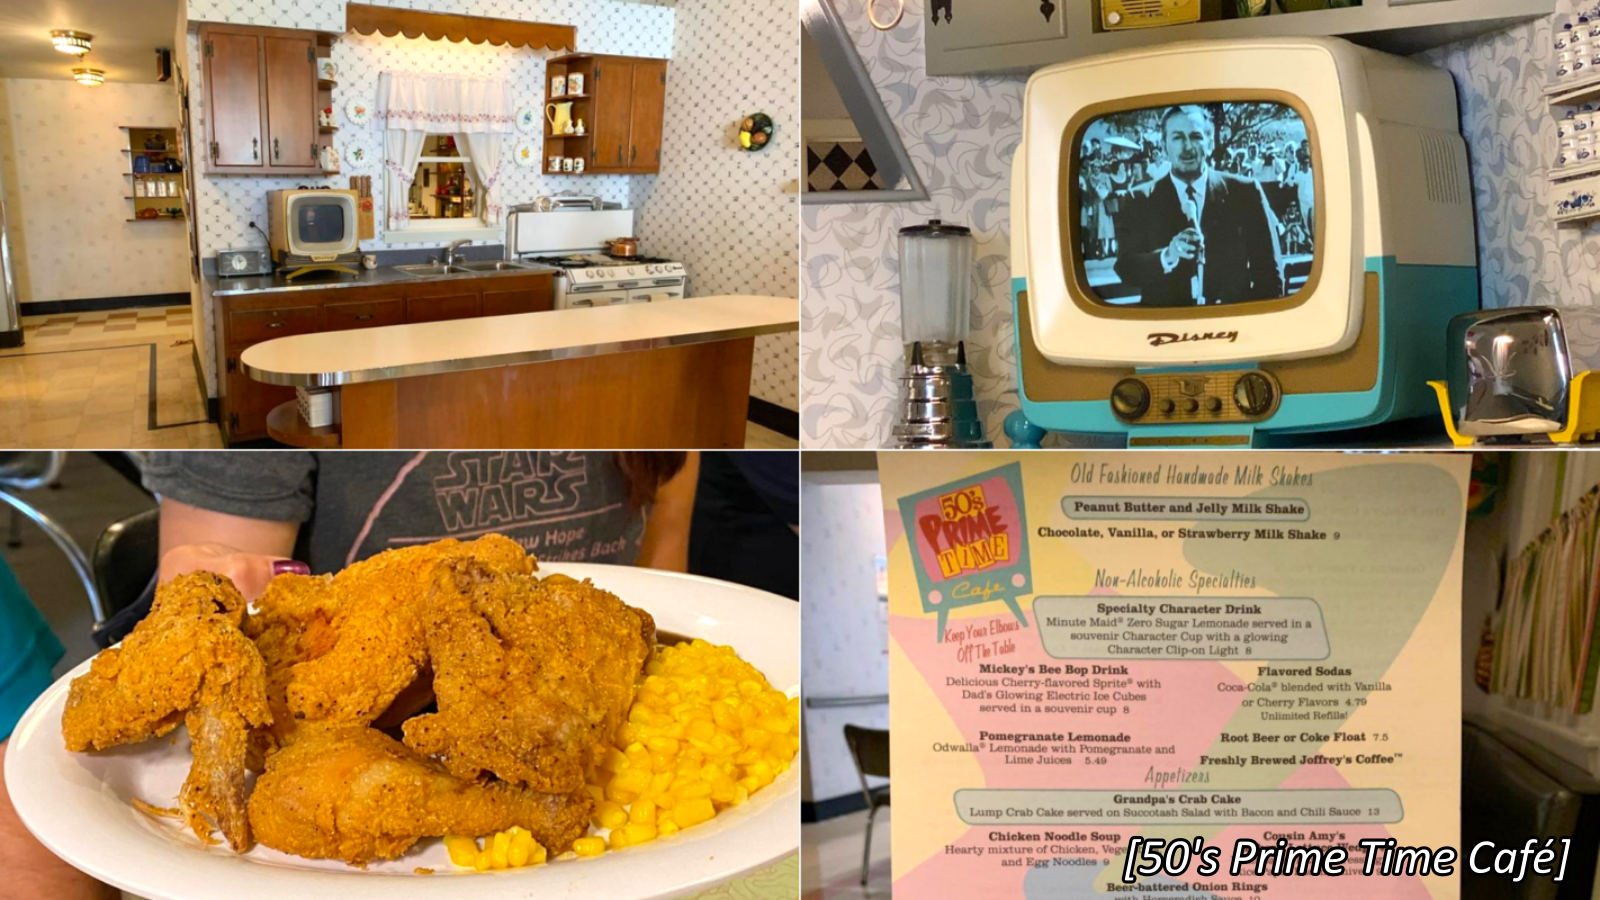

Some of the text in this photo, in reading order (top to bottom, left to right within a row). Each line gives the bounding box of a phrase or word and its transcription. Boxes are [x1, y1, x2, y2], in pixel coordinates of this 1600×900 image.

[1147, 330, 1239, 346] Disney
[433, 451, 586, 491] STAR
[1070, 462, 1314, 487] Old Fashioned Handmade Milk Shakes
[436, 470, 588, 532] WARS
[943, 491, 985, 520] 50's
[1074, 501, 1305, 516] Peanut Butter and Jelly Milk Shake
[919, 505, 1009, 554] PRIME
[1037, 526, 1340, 541] Chocolate, Vanilla, or Strawberry Milk Shake 9
[545, 526, 586, 547] Hope
[590, 539, 626, 557] Back
[940, 535, 1007, 574] TIME
[1095, 568, 1256, 595] Non-Alcoholic Specialties
[1097, 603, 1262, 616] Specialty Character Drink
[1046, 617, 1087, 627] Minute
[1127, 617, 1153, 628] Zero
[1155, 617, 1189, 629] Sugar
[1192, 618, 1249, 628] Lemonade
[1252, 619, 1288, 629] served
[1291, 619, 1302, 629] in
[1305, 621, 1312, 629] a
[944, 619, 1020, 645] Keep Your Elbows
[1070, 630, 1289, 644] souvenir Character Cup with a glowing
[957, 641, 1016, 663] Off The Table
[1107, 644, 1252, 657] Character Clip-on Light 8
[979, 664, 1129, 677] Mickey's Bee Bop Drink
[1257, 666, 1352, 677] Flavored Sodas
[945, 676, 999, 687] Delicious
[1001, 677, 1090, 689] Cherry-flavored
[1136, 679, 1162, 689] with
[1281, 682, 1323, 692] blended
[1327, 682, 1351, 692] with
[1355, 681, 1392, 691] Vanilla
[962, 690, 1147, 702] Dad's Glowing Electric Ice Cubes
[979, 703, 1130, 716] served in a souvenir cup 8
[1242, 697, 1368, 709] or Cherry Flavors 4.79
[1260, 710, 1348, 721] Unlimited Refills!
[979, 731, 1131, 743] Pomegranate Lemonade
[1220, 732, 1389, 743] Root Beer or Coke Float 7.5
[989, 743, 1047, 754] Lemonade
[1051, 744, 1075, 754] with
[1079, 744, 1152, 756] Pomegranate
[1155, 745, 1176, 754] and
[1004, 755, 1107, 765] Lime Juices 5.49
[1200, 755, 1247, 767] Freshly
[1250, 755, 1297, 766] Brewed
[1299, 754, 1352, 767] Joffrey's
[1144, 765, 1211, 789] Appetizers
[1113, 794, 1242, 806] Grandpa's Crab Cake
[969, 806, 1380, 819] Lump Crab Cake served on Succotash Salad with Bacon and Chili Sauce 13
[988, 831, 1121, 844] Chicken Noodle Soup
[1263, 830, 1346, 842] Cousin Amy's
[944, 845, 985, 857] Hearty
[988, 845, 1034, 855] mixture
[1036, 845, 1048, 855] of
[1050, 844, 1099, 856] Chicken,
[1001, 857, 1110, 869] and Egg Noodles 9
[1106, 881, 1268, 893] Beer-battered Onion Rings
